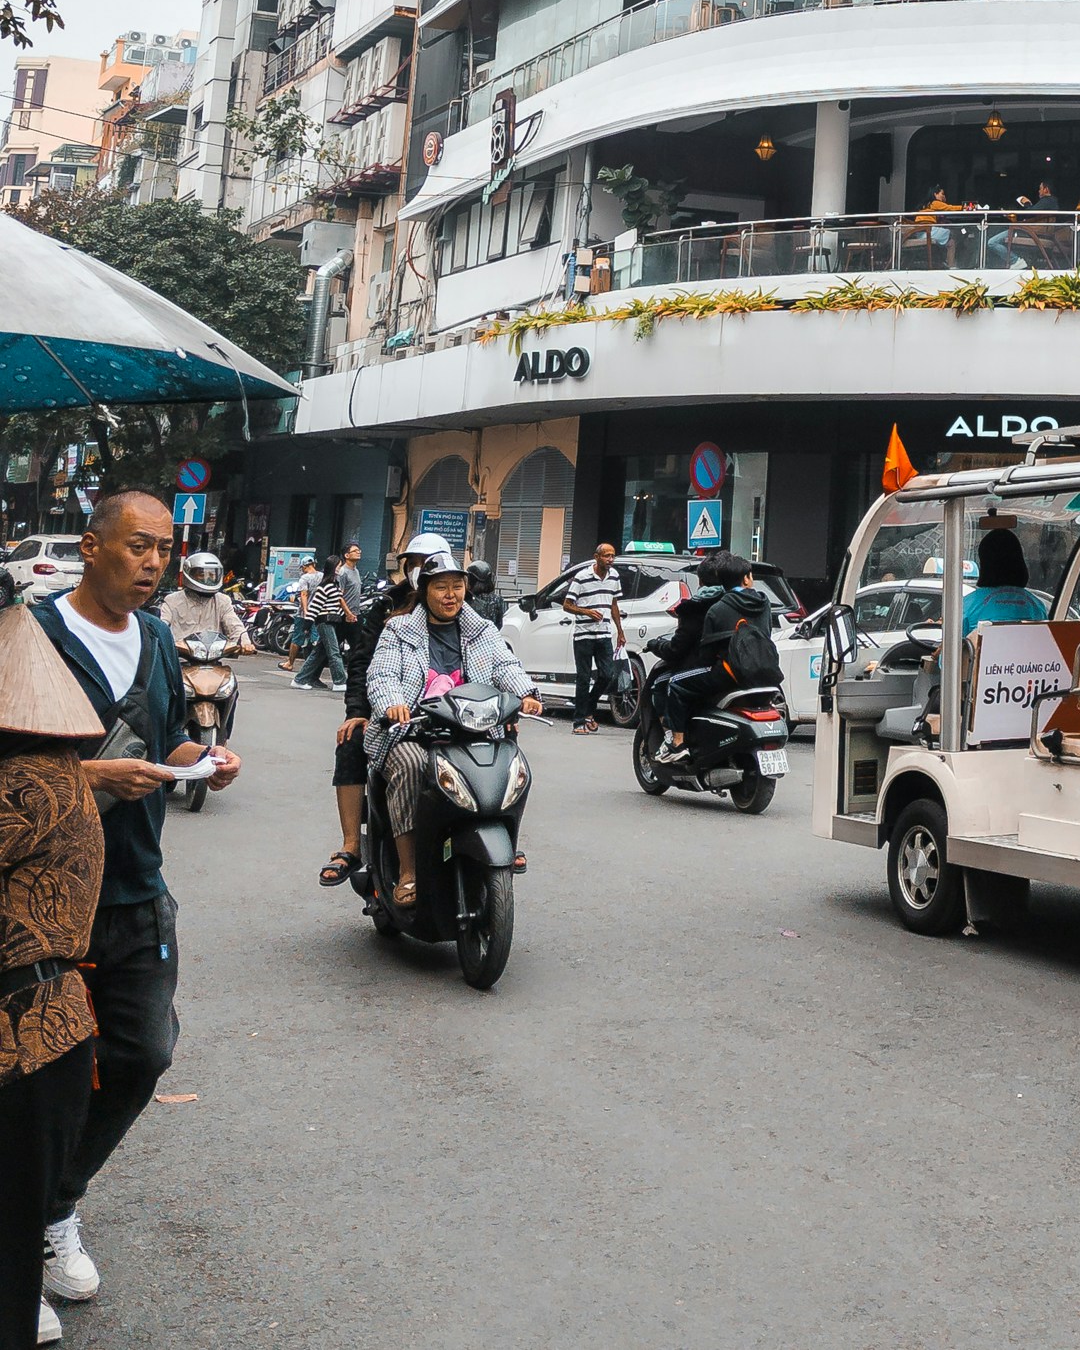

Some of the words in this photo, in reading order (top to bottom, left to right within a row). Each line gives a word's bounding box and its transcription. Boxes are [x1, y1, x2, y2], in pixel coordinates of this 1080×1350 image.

[513, 345, 591, 383] ALDO
[945, 415, 1059, 437] ALDO
[985, 664, 1002, 676] LIÊN
[1003, 663, 1015, 676] HỆ
[1016, 662, 1042, 675] QUẢNG
[1044, 661, 1061, 672] CÁO
